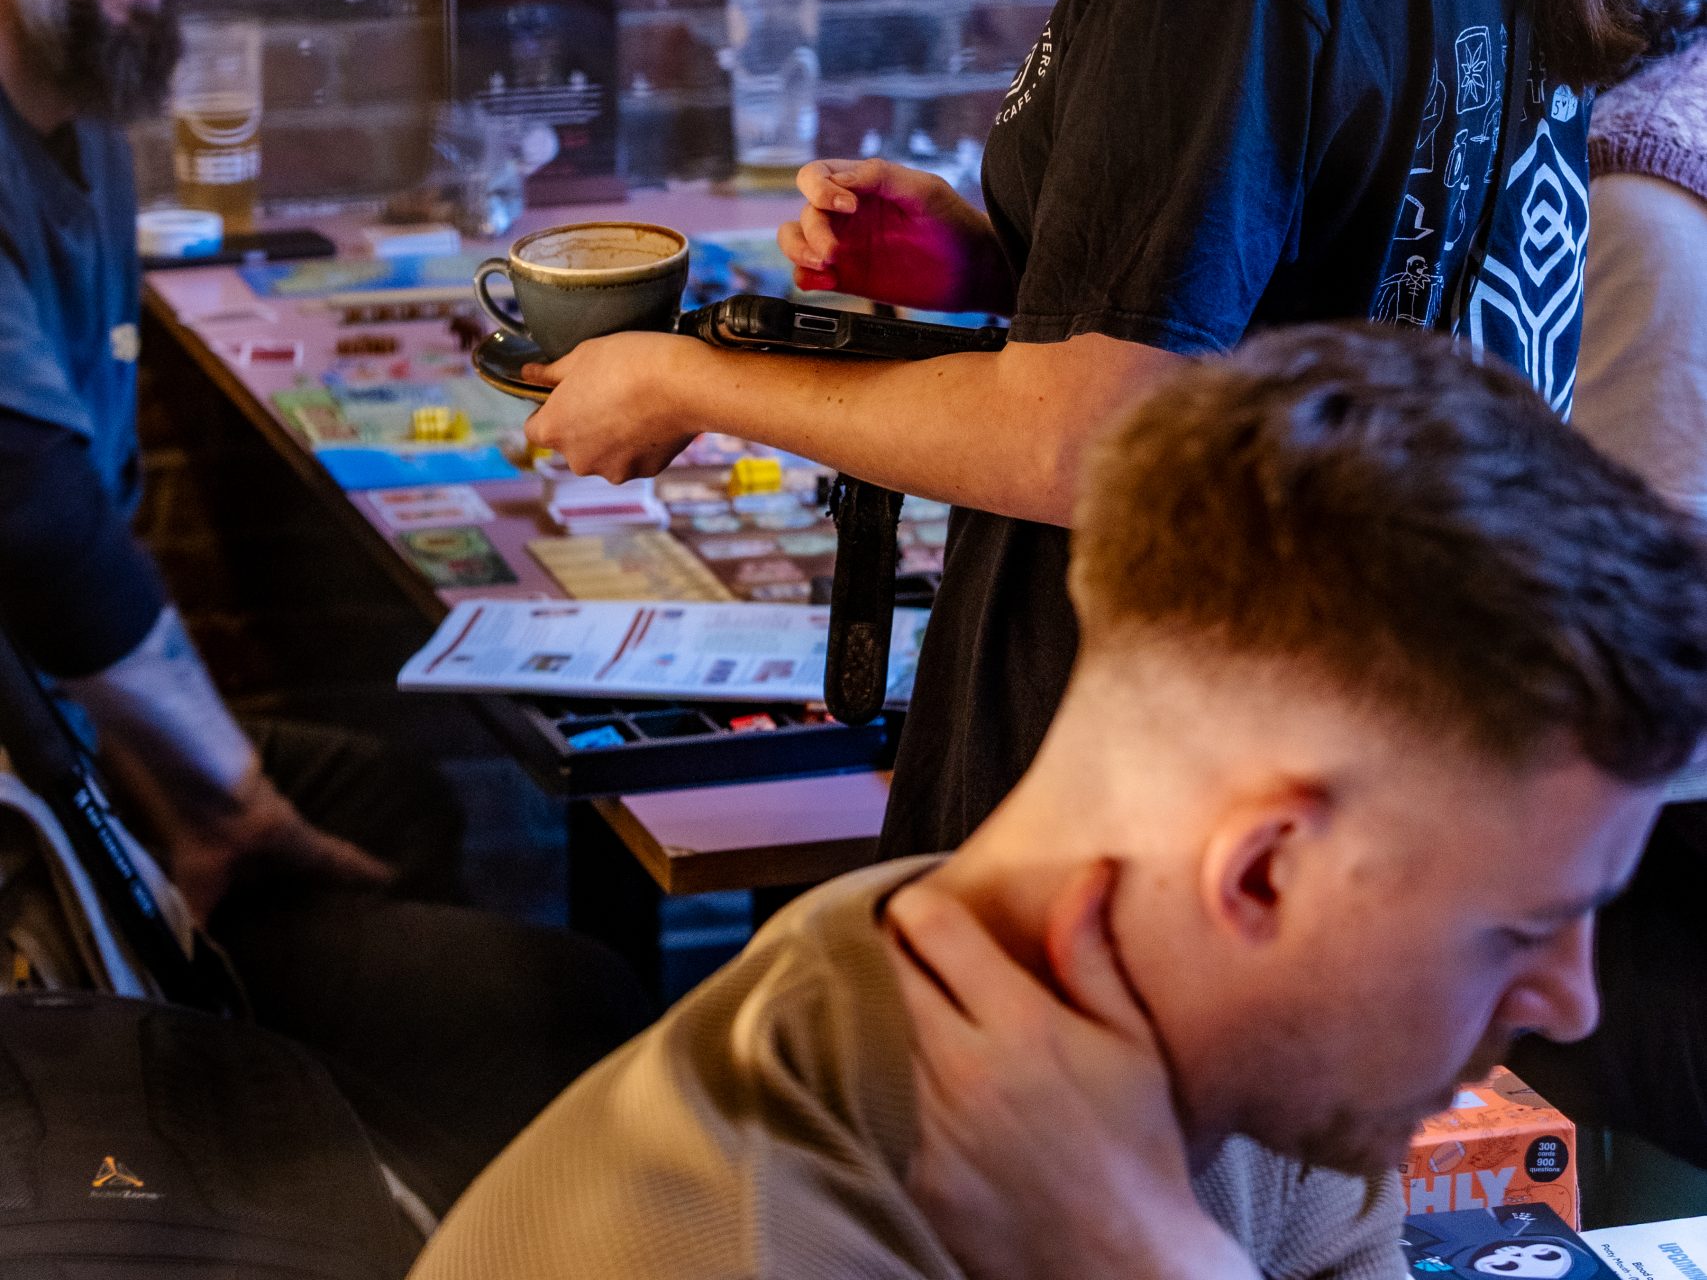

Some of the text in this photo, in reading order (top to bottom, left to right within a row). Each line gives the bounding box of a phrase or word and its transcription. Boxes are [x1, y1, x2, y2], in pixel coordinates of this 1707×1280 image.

[1038, 19, 1052, 78] TERS
[1002, 89, 1032, 123] CAFE
[1538, 1142, 1556, 1151] 300
[1529, 1166, 1561, 1174] questions
[1536, 1158, 1555, 1167] 900
[1403, 1167, 1517, 1215] HLY
